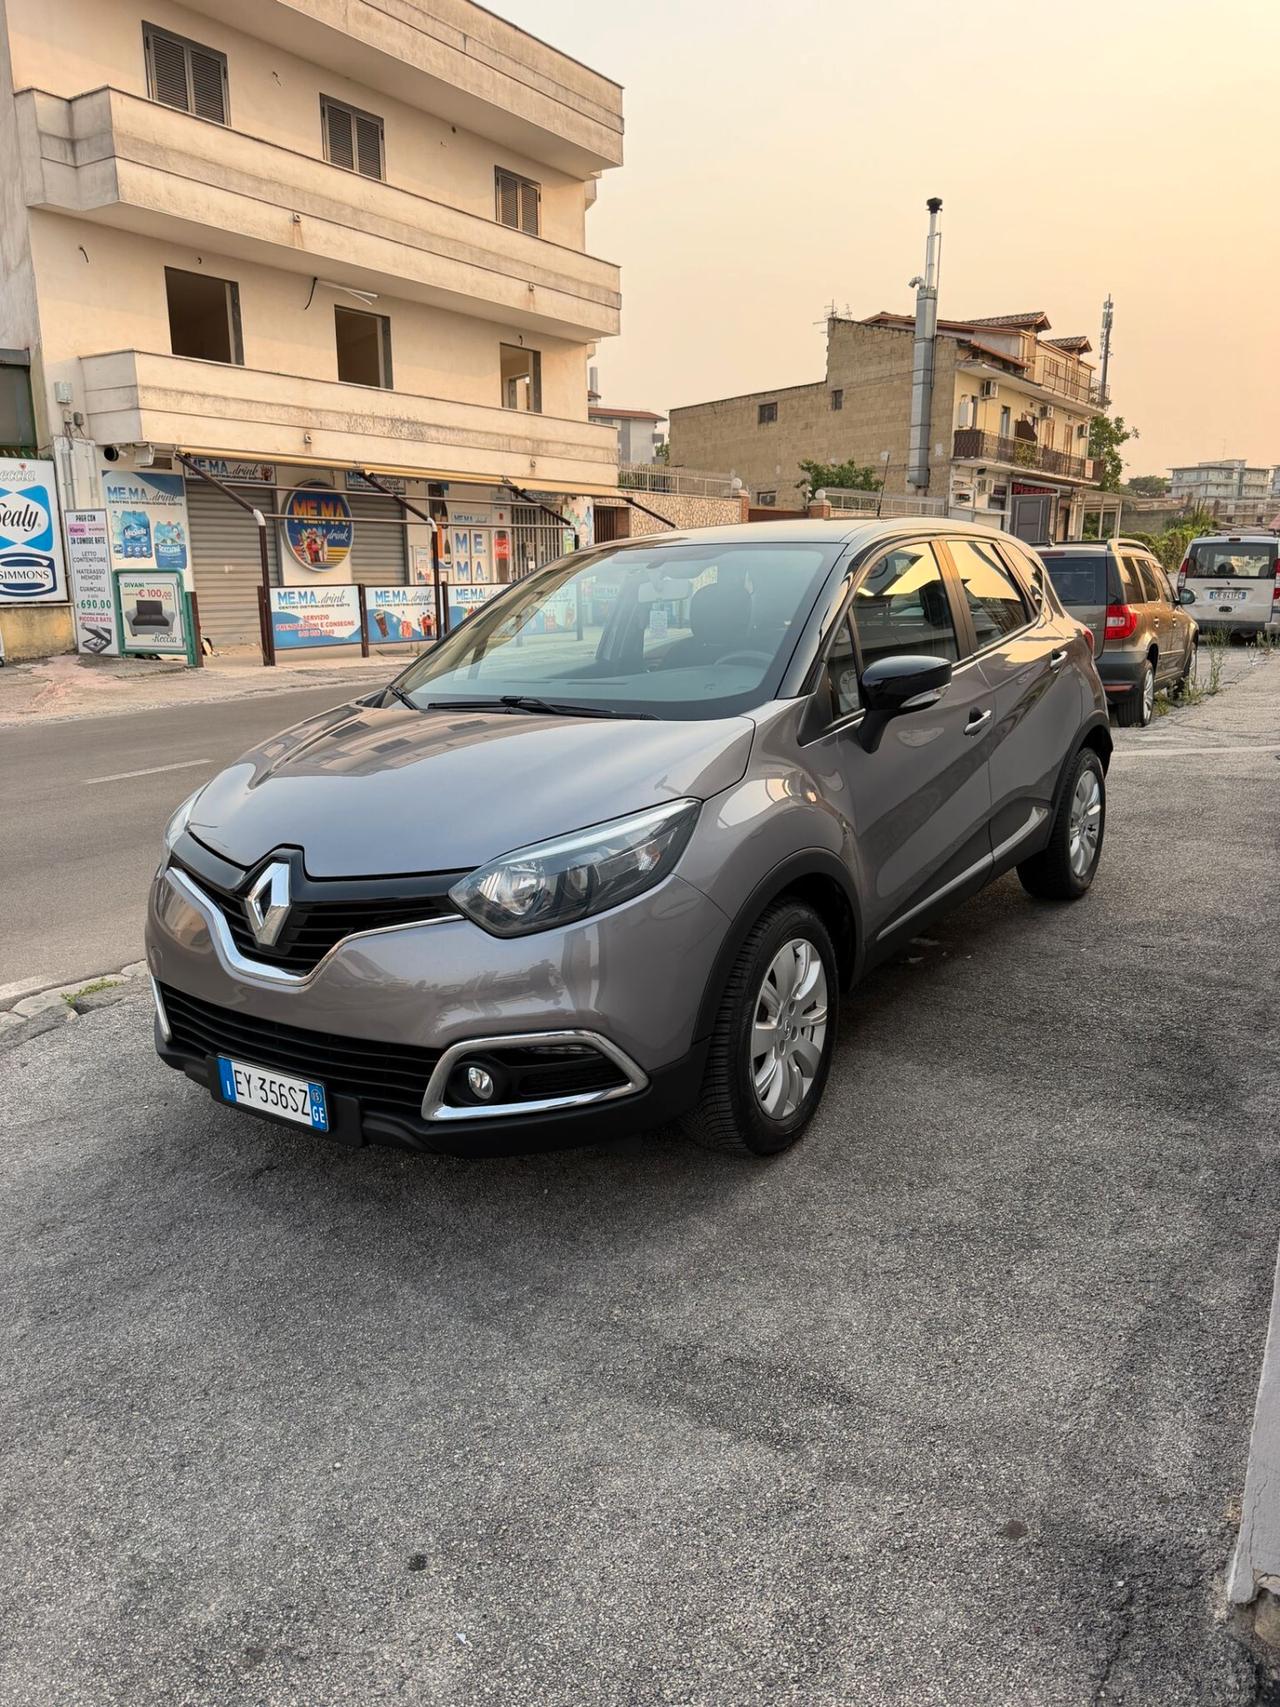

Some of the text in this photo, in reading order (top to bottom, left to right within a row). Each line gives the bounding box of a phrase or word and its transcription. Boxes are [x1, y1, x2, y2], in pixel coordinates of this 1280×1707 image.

[321, 589, 345, 604] drink
[325, 620, 356, 628] CONSEGNE
[226, 1080, 232, 1096] I
[234, 1069, 311, 1117] EY 356SZ
[312, 1105, 326, 1124] GE
